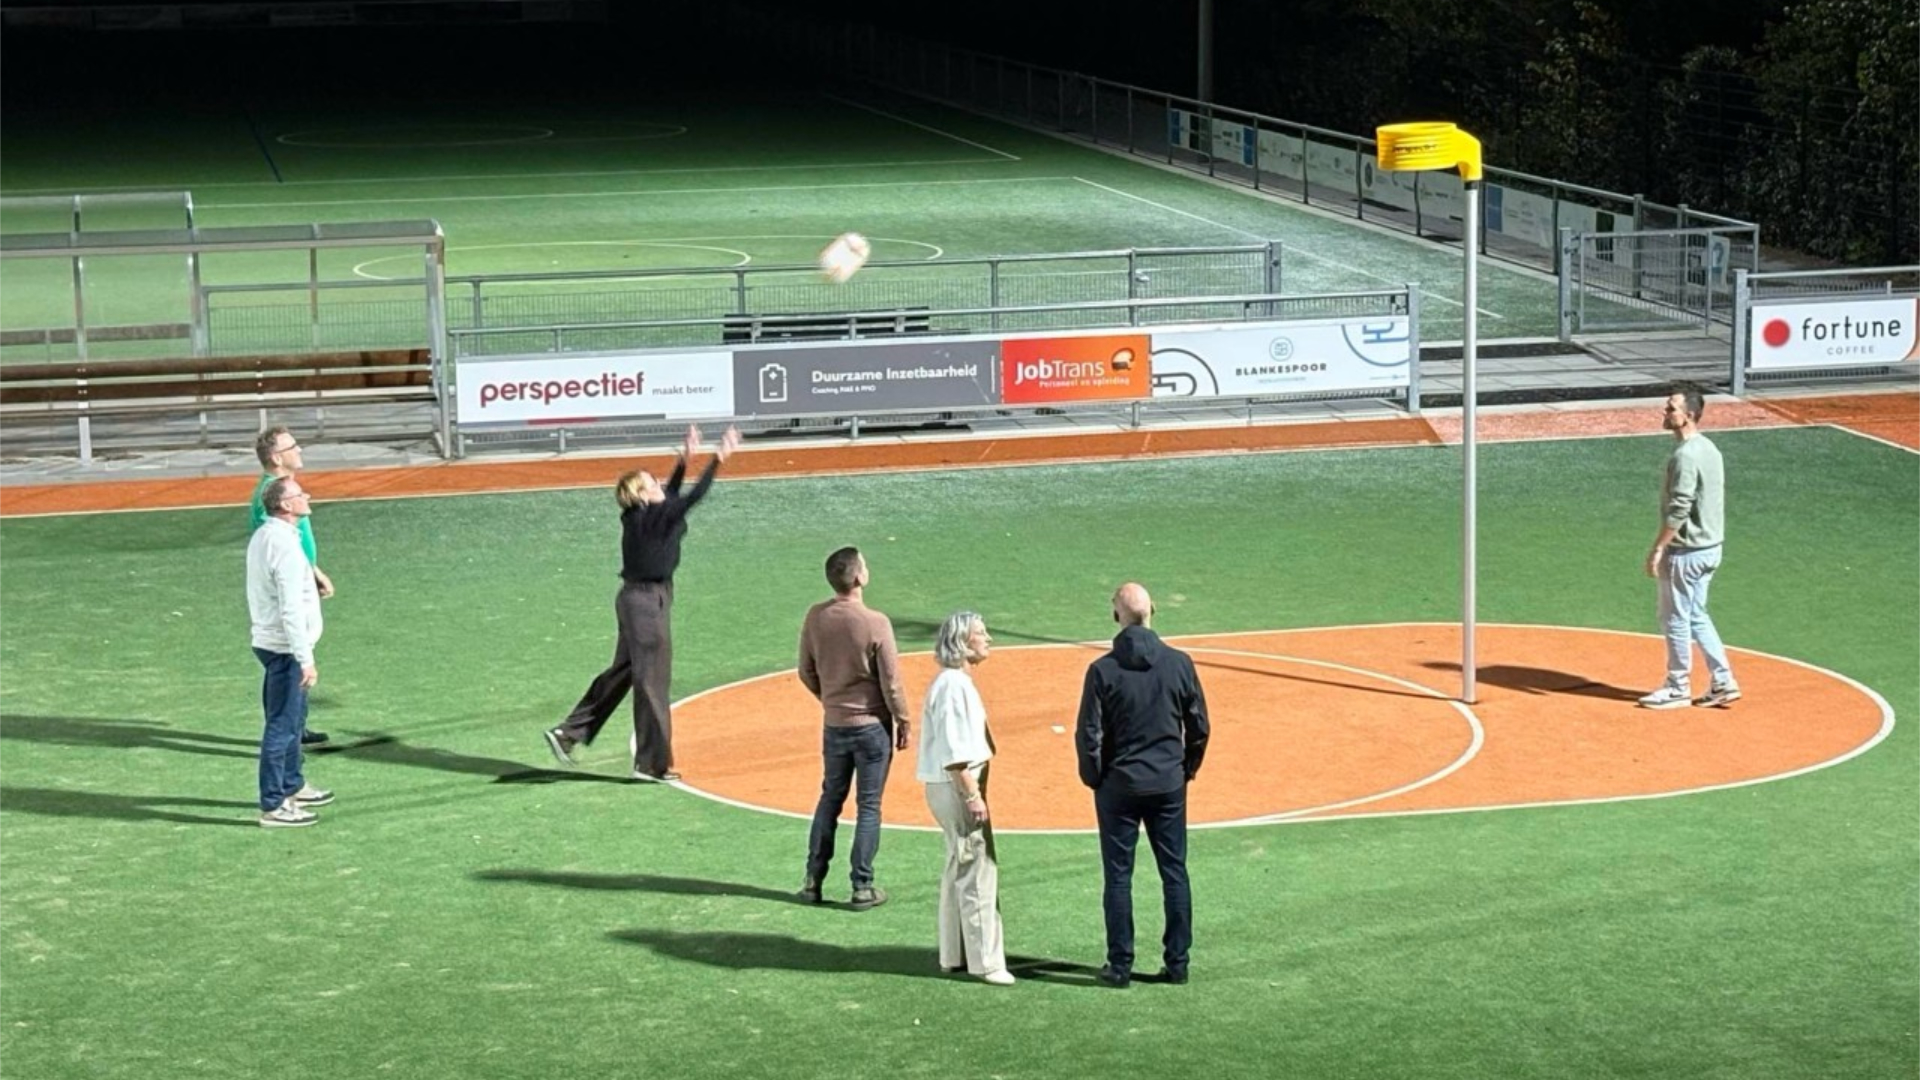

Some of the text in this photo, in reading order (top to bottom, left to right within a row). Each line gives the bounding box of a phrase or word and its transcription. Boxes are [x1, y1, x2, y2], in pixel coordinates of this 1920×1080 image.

[1802, 316, 1901, 341] fortune
[1826, 346, 1875, 355] COFFEE
[811, 364, 978, 383] Duurzame Inzetbaarheid
[1014, 359, 1105, 385] JobTrans
[1235, 362, 1327, 376] BLANKESPOOR
[480, 371, 645, 408] perspectief
[652, 384, 714, 396] maakt beter
[1039, 377, 1130, 388] Personeel en opleiding
